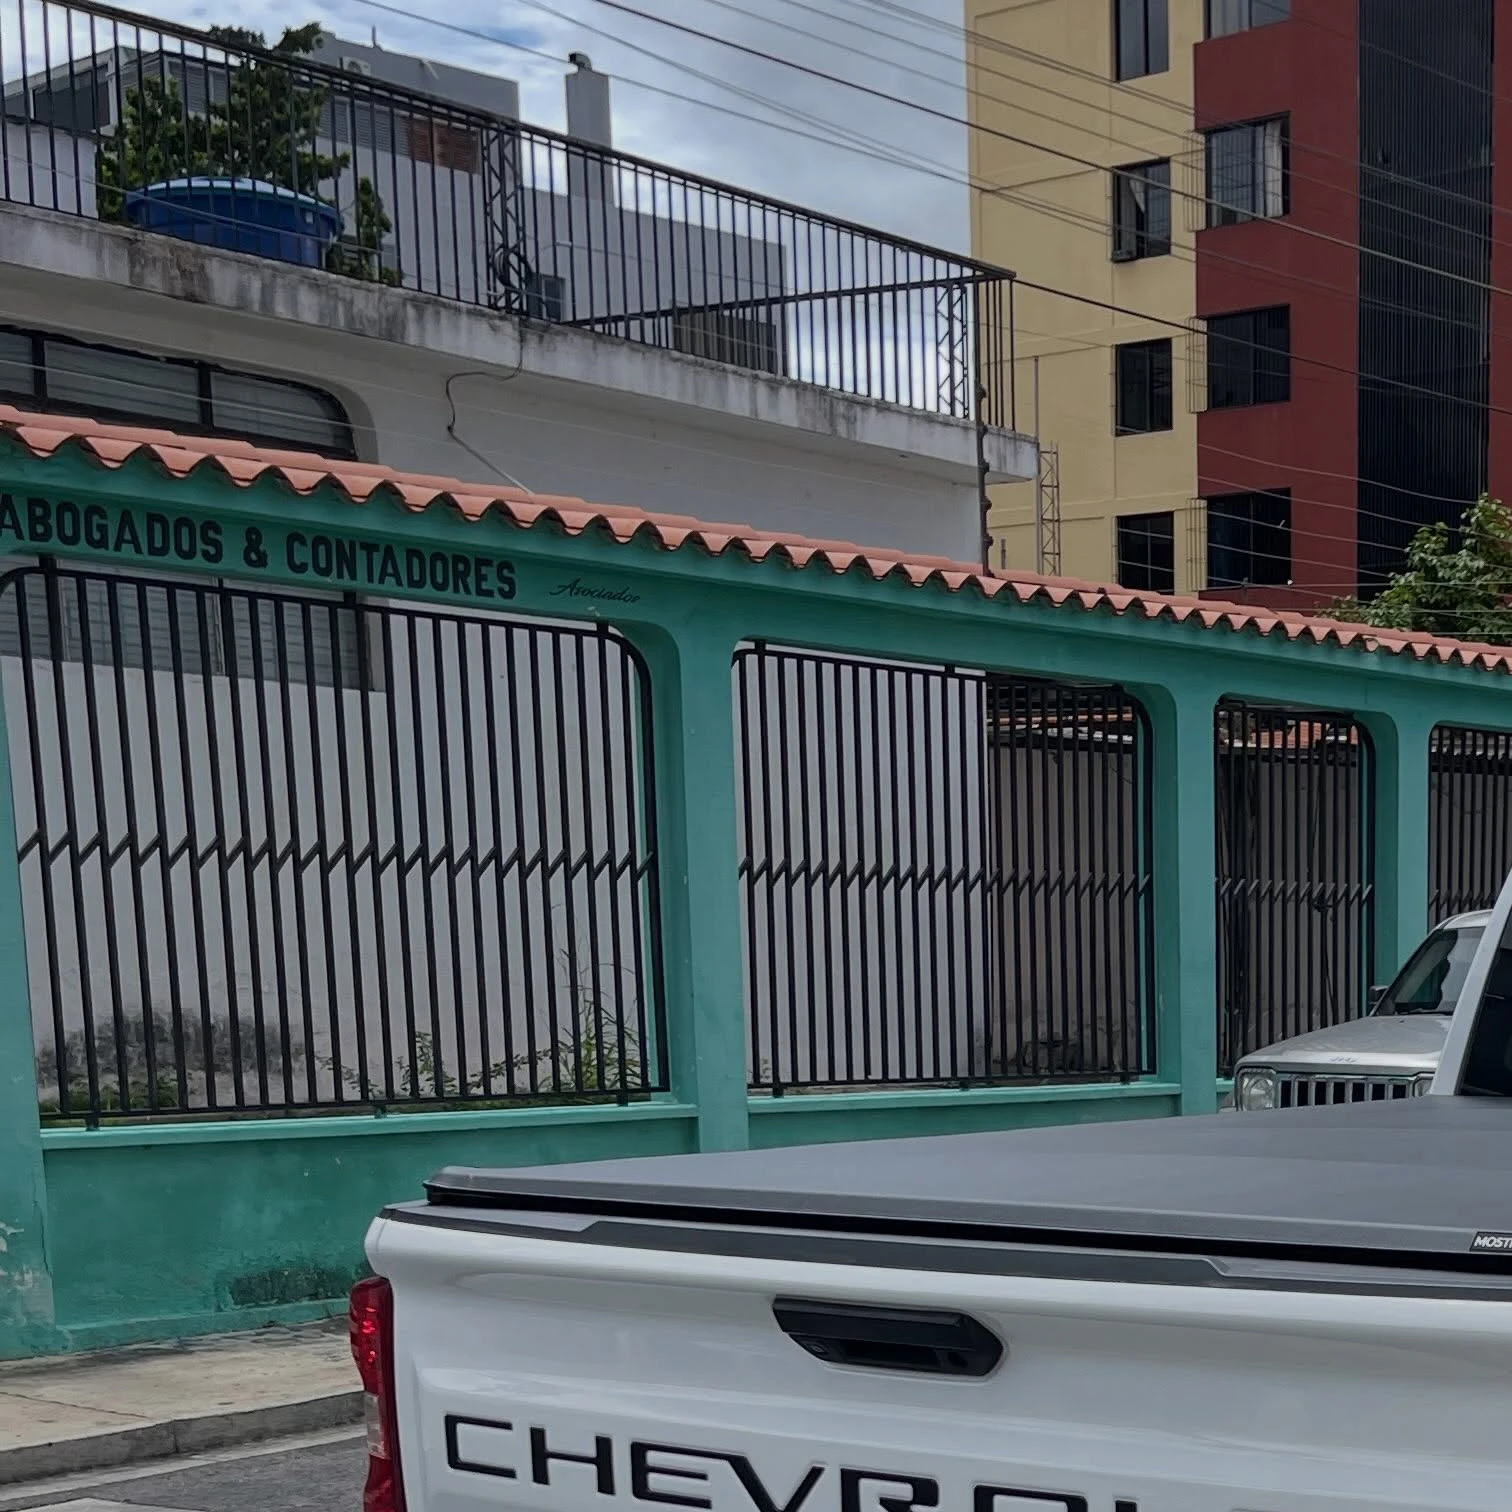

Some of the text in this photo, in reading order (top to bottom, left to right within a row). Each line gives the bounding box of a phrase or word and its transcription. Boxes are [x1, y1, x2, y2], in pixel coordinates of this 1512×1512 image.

[0, 493, 517, 600] ABOGADOS & CONTADORES
